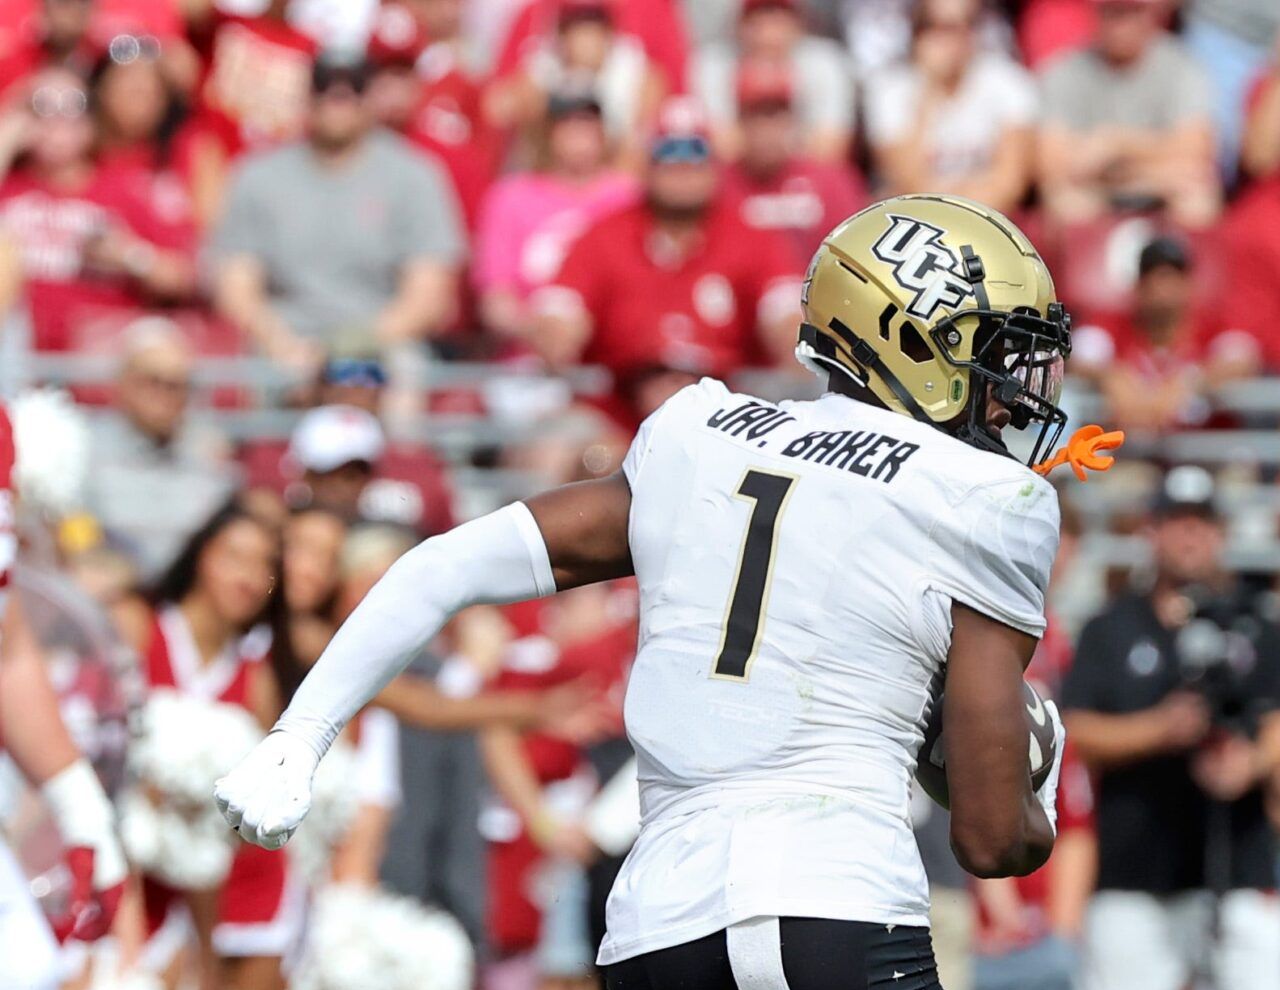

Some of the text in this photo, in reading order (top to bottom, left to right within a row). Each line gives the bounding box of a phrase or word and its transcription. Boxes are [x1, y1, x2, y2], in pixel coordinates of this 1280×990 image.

[870, 213, 976, 321] UCF
[706, 401, 916, 483] JAV. BAKER
[708, 465, 800, 682] 1
